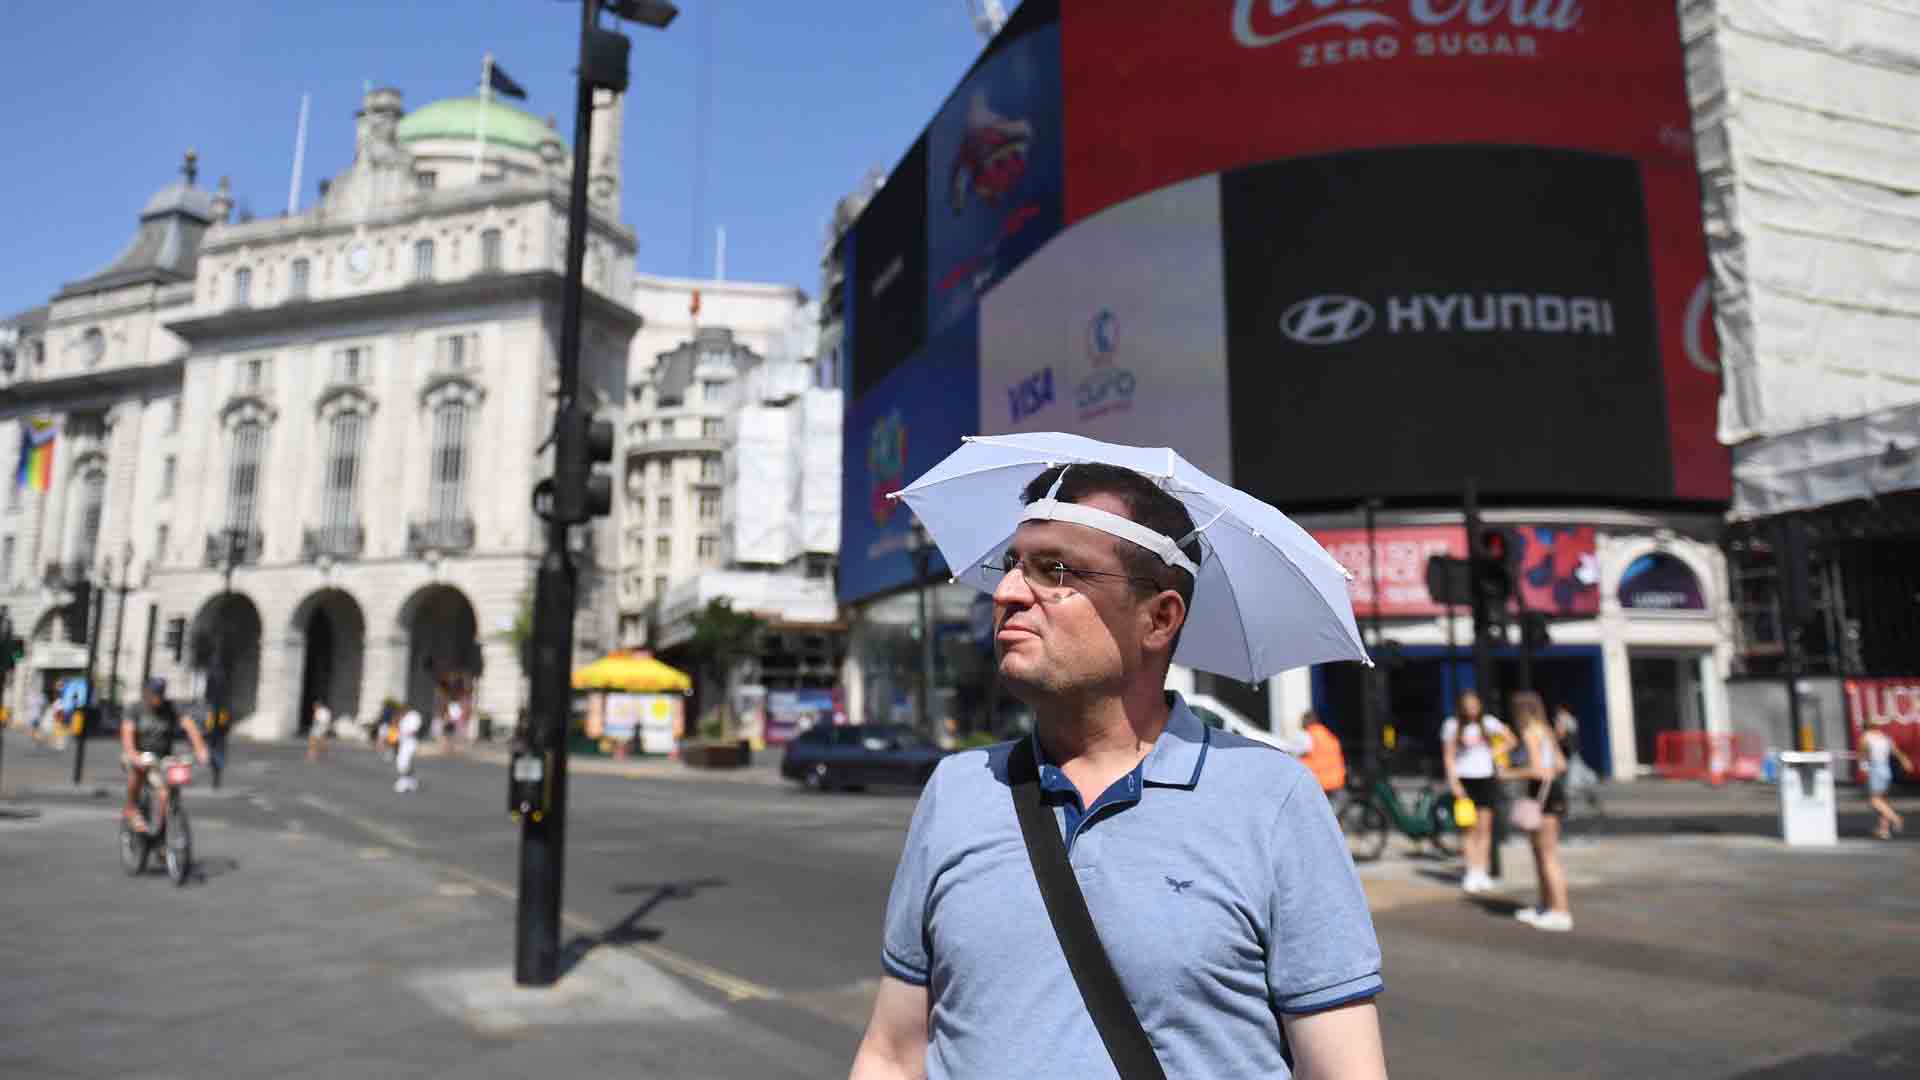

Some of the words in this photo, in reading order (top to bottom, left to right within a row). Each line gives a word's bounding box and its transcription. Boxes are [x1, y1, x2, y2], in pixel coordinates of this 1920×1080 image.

[1298, 34, 1399, 68] ZERO
[1414, 32, 1536, 57] SUGAR
[1387, 294, 1615, 335] HYUNDAI
[1007, 365, 1055, 423] VISA
